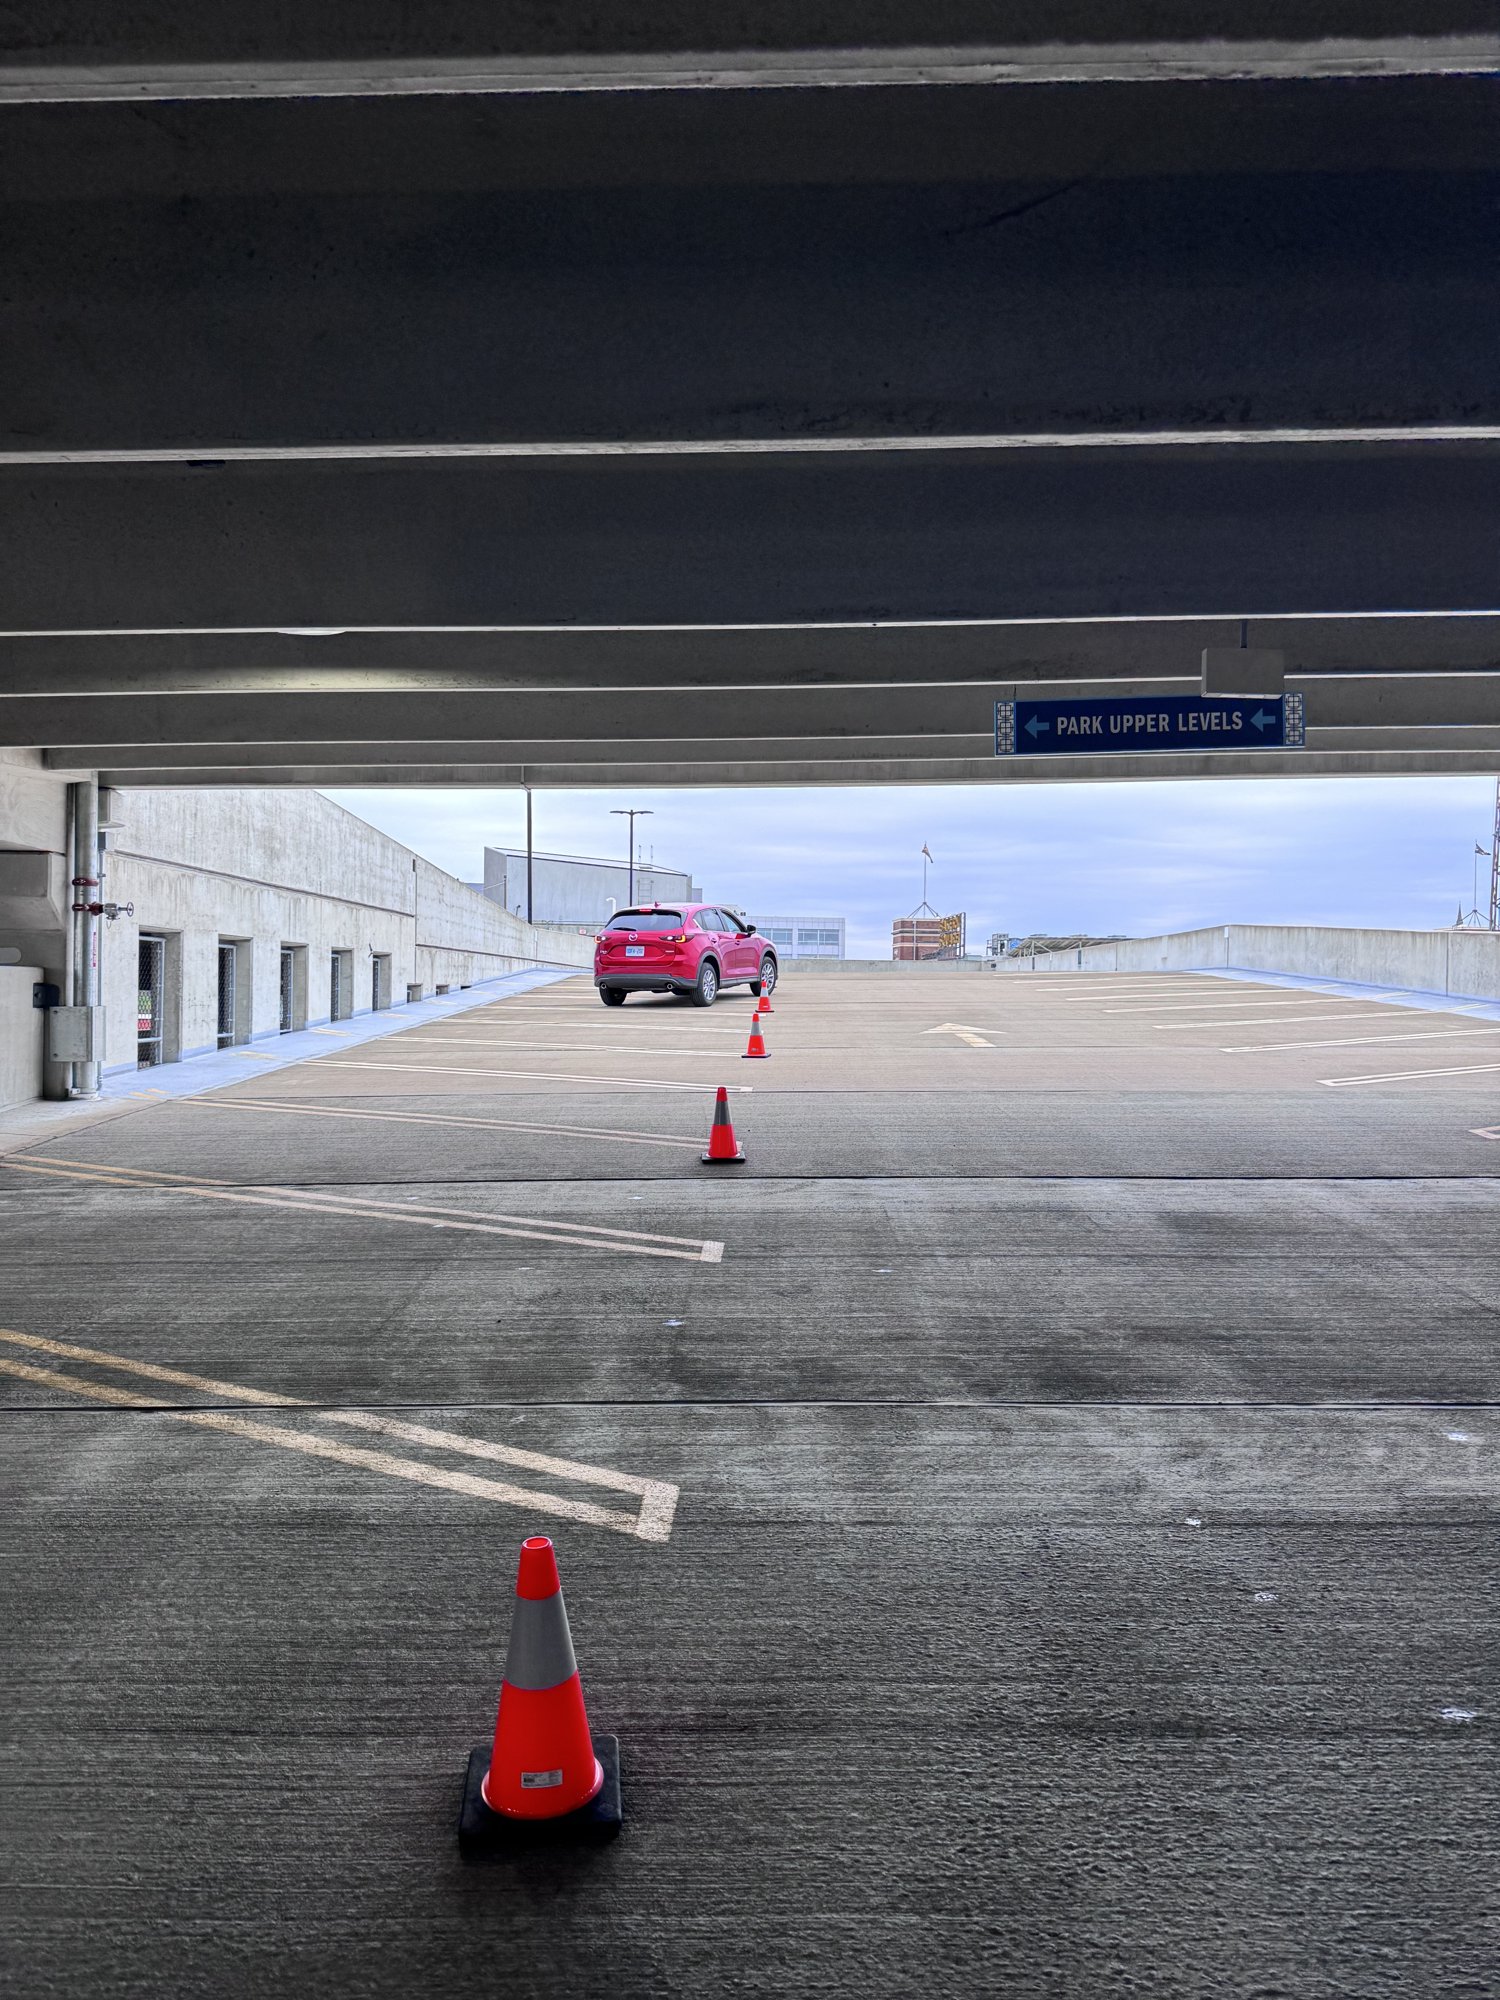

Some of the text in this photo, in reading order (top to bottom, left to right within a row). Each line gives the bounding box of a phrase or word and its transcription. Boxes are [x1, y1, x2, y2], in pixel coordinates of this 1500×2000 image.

[1056, 711, 1243, 736] PARK UPPER LEVELS
